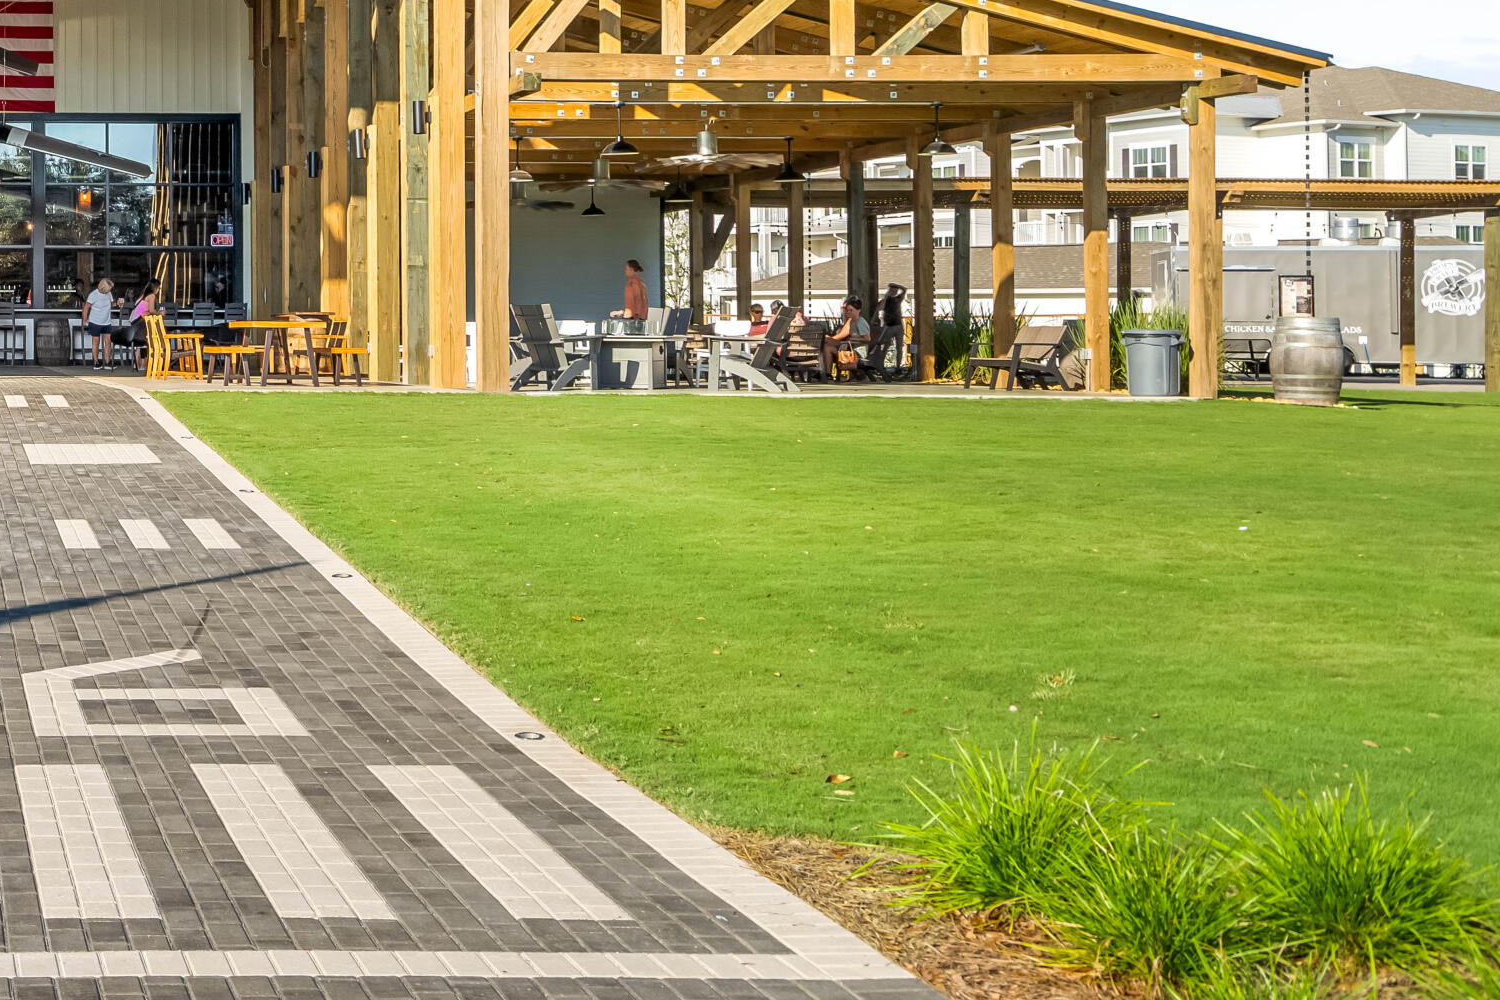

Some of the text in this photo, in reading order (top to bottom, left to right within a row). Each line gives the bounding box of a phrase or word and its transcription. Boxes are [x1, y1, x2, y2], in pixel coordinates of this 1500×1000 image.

[212, 234, 232, 245] OPEN
[1224, 325, 1264, 333] CHICKEN
[1340, 326, 1362, 334] ADS
